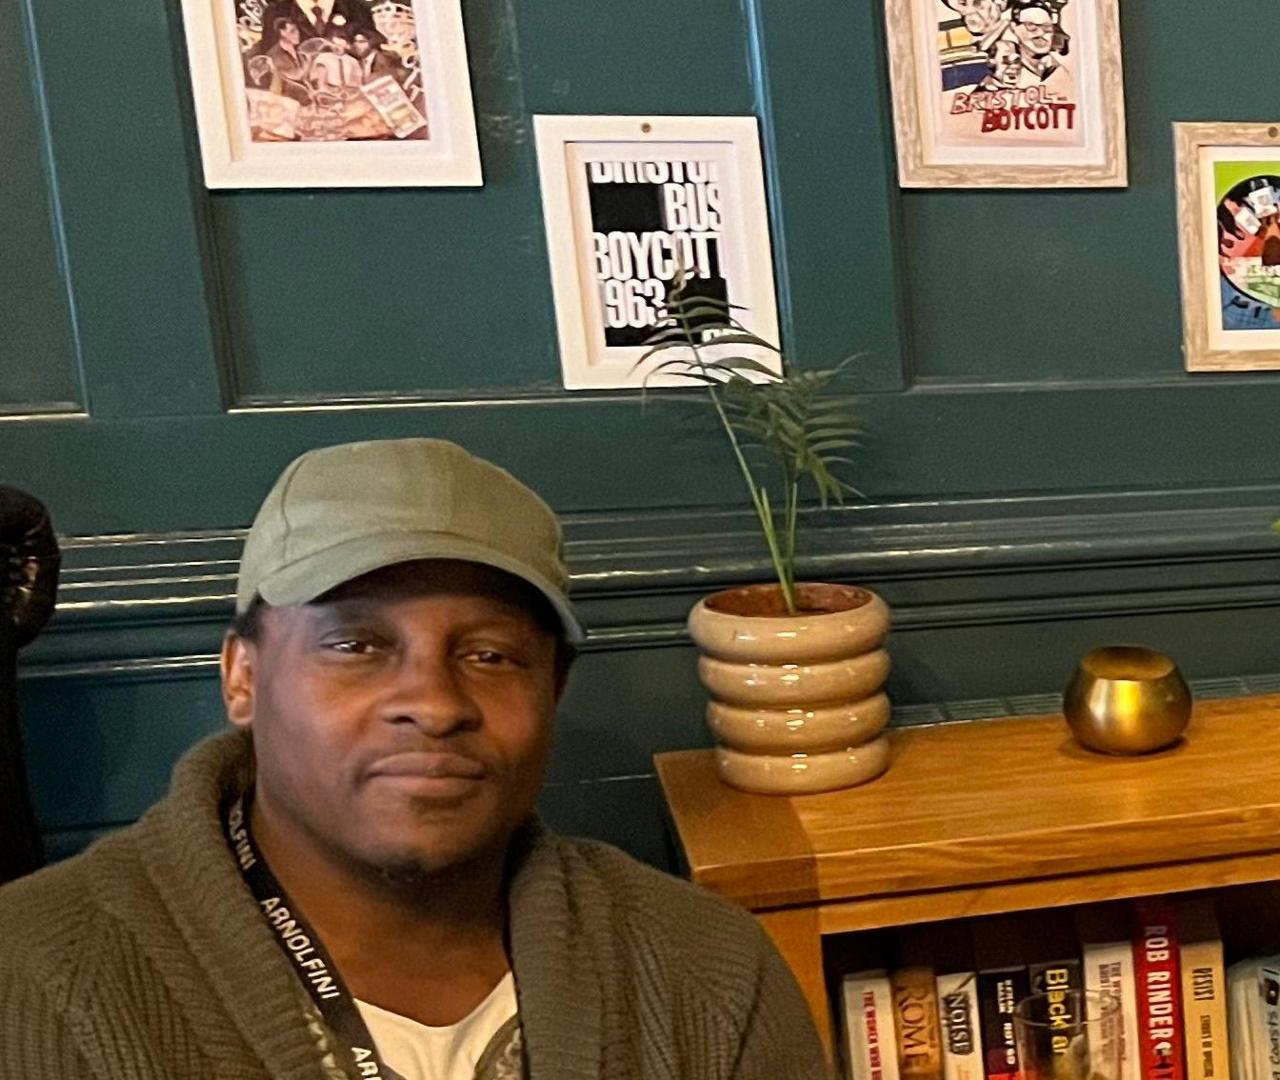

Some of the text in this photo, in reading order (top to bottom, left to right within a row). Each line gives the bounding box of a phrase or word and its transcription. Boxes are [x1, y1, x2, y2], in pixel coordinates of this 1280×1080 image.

[950, 85, 1052, 115] BRISTOL
[981, 103, 1076, 133] BOYCOTT
[663, 182, 721, 232] BUS
[228, 803, 256, 871] OLFINI
[260, 896, 341, 1000] ARNOLFINI
[1045, 969, 1072, 1029] Black
[1144, 925, 1175, 1040] ROB RINDER
[1192, 968, 1216, 1001] RESIST
[896, 974, 931, 1073] ROME
[950, 991, 973, 1054] NOISE
[1266, 1010, 1280, 1066] Coasts
